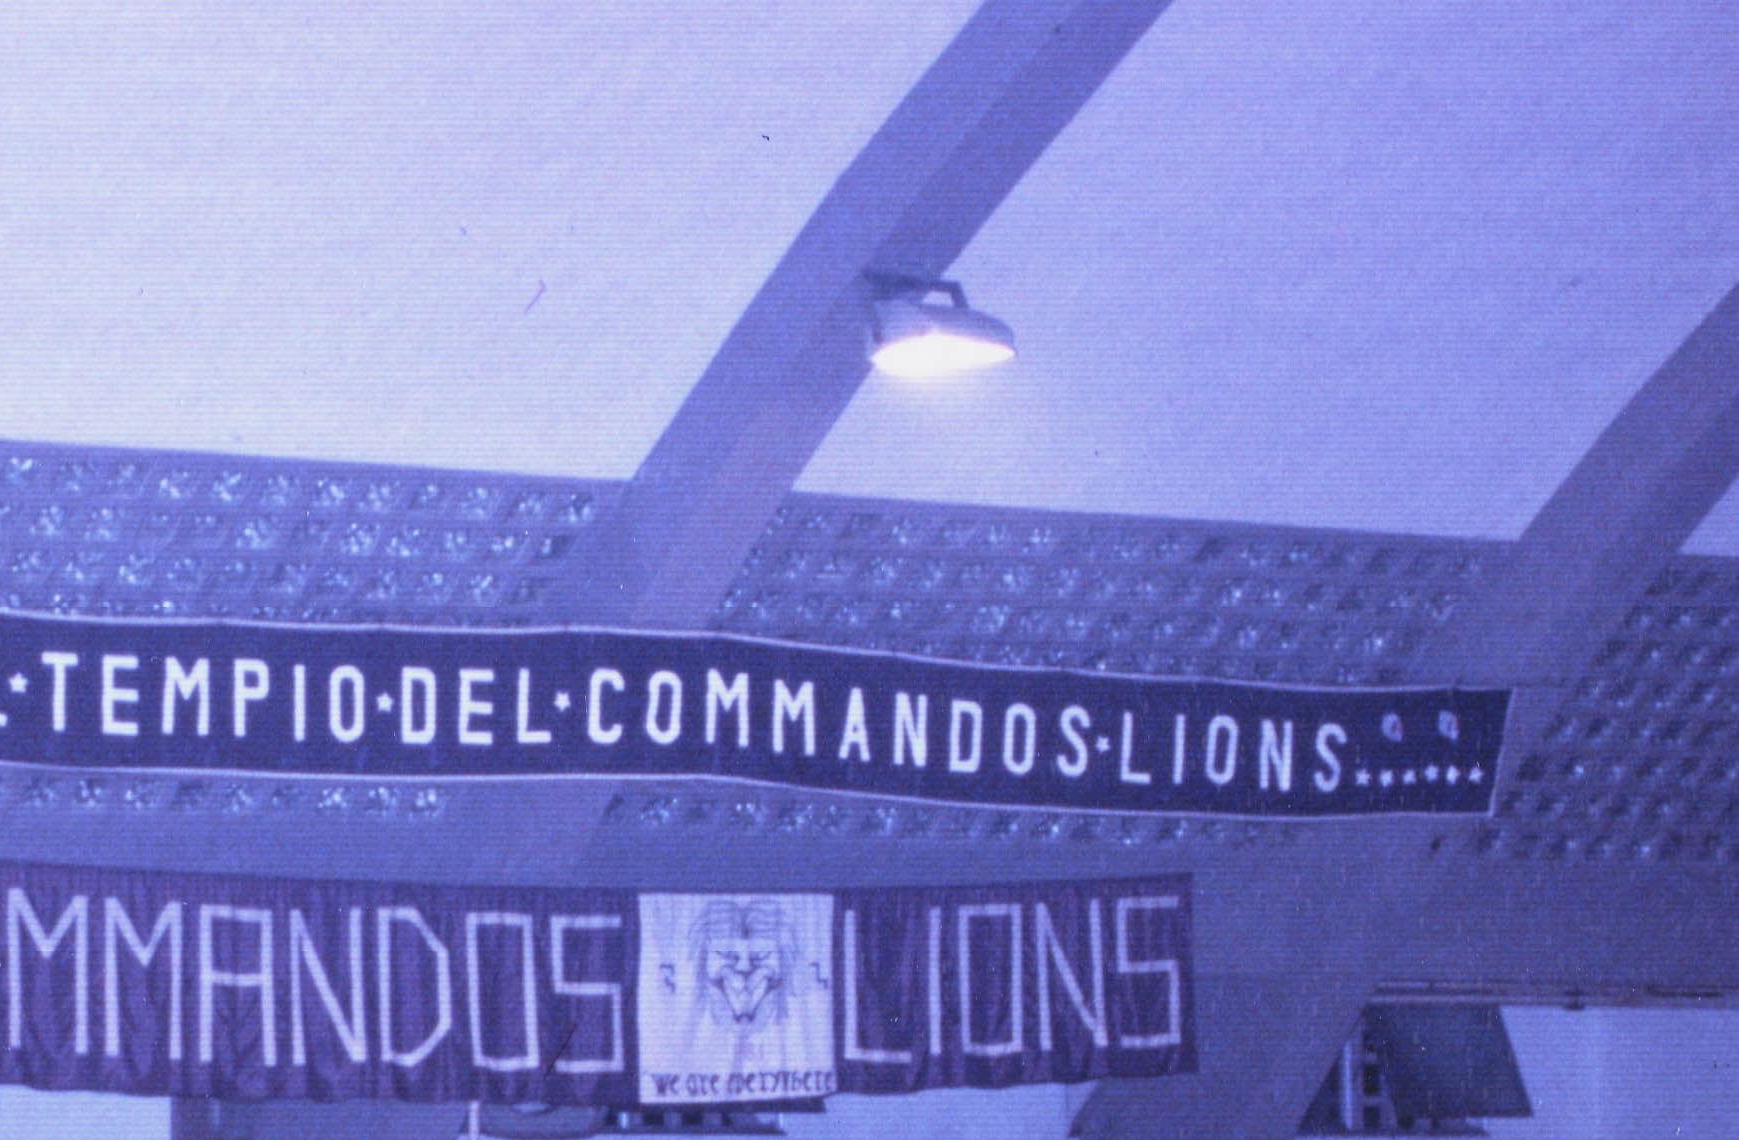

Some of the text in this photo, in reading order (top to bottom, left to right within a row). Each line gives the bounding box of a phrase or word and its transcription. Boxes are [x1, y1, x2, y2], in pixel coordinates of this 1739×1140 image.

[41, 651, 366, 743] TEMPIO
[401, 666, 552, 746] DEL
[587, 668, 1091, 776] COMMANDOS
[842, 893, 1183, 1064] LIONS
